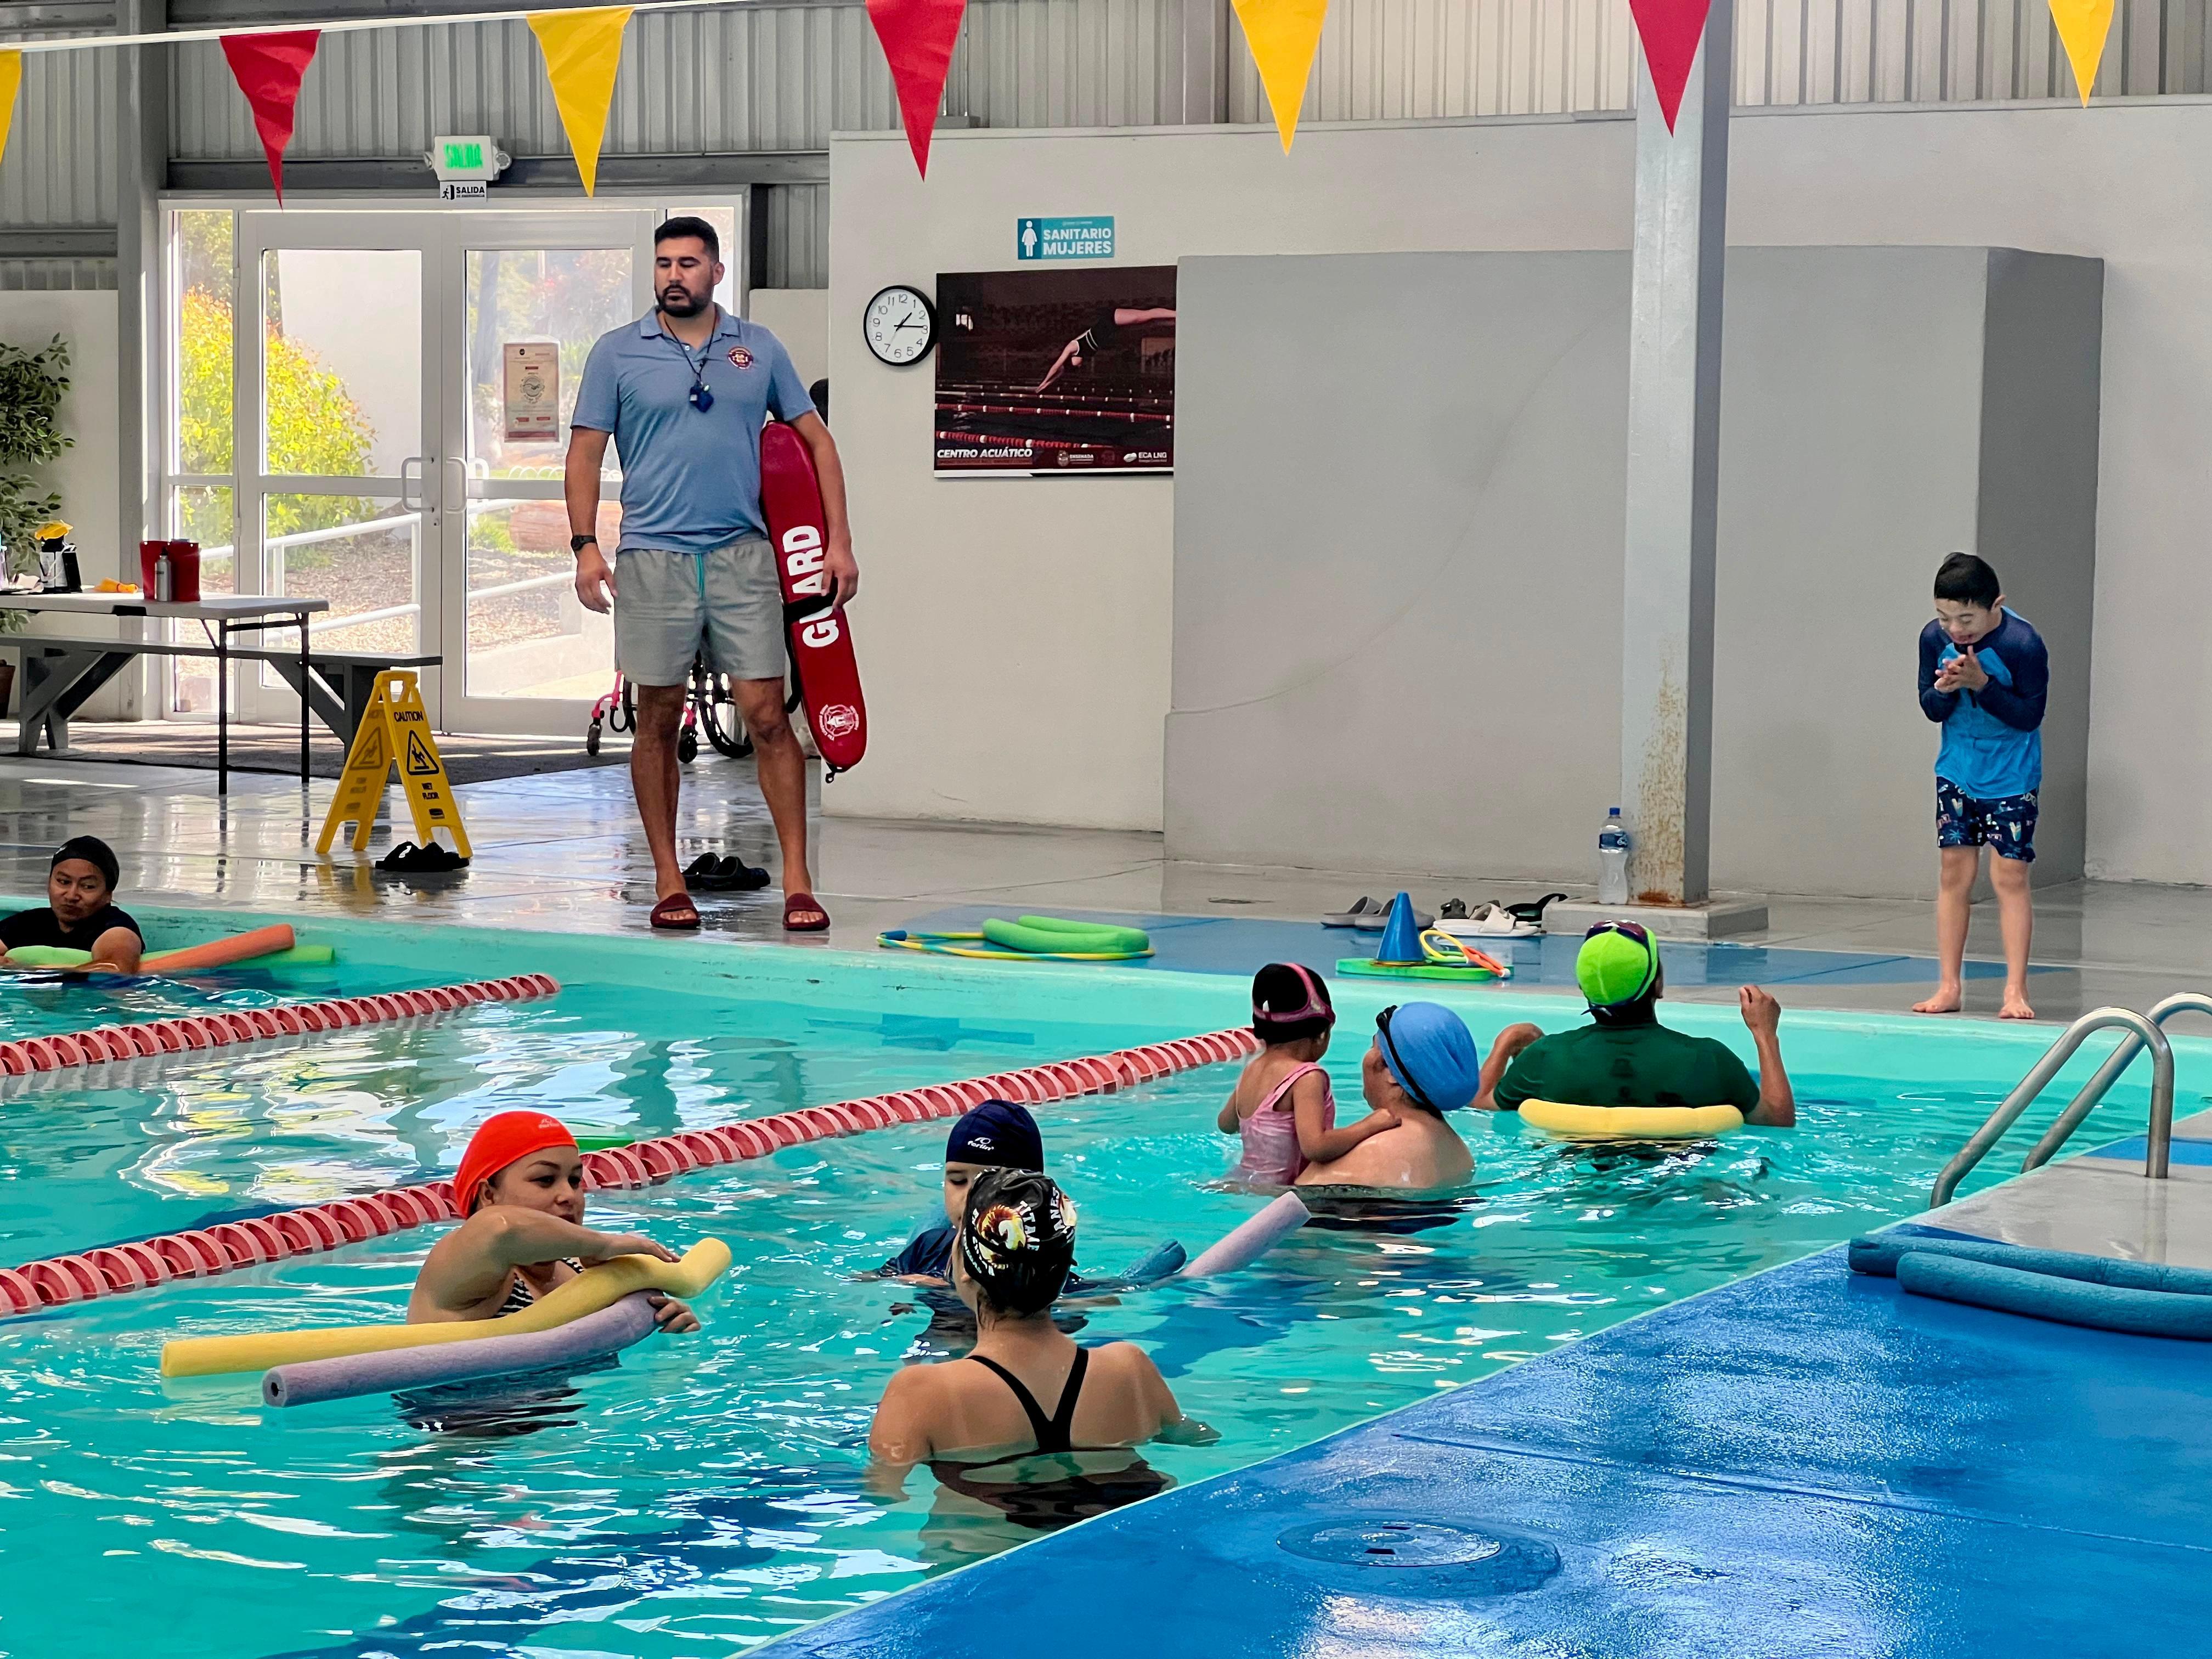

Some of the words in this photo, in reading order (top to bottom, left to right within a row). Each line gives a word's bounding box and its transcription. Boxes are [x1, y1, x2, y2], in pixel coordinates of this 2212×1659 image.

[1043, 228, 1111, 240] SANITARIO
[1043, 241, 1112, 255] MUJERES
[888, 296, 895, 306] 11
[899, 294, 907, 303] 12
[913, 299, 916, 308] 1
[878, 305, 888, 314] 10
[918, 310, 926, 319] 2
[873, 318, 881, 327] 9
[921, 325, 928, 334] 3
[875, 332, 882, 341] 8
[916, 338, 923, 347] 4
[884, 343, 891, 353] 7
[907, 347, 913, 356] 5
[894, 348, 902, 358] 6
[936, 449, 978, 458] CENTRO
[979, 446, 1033, 458] ACUÁTICO
[393, 711, 424, 723] CAUTION
[422, 792, 439, 800] FLOOR
